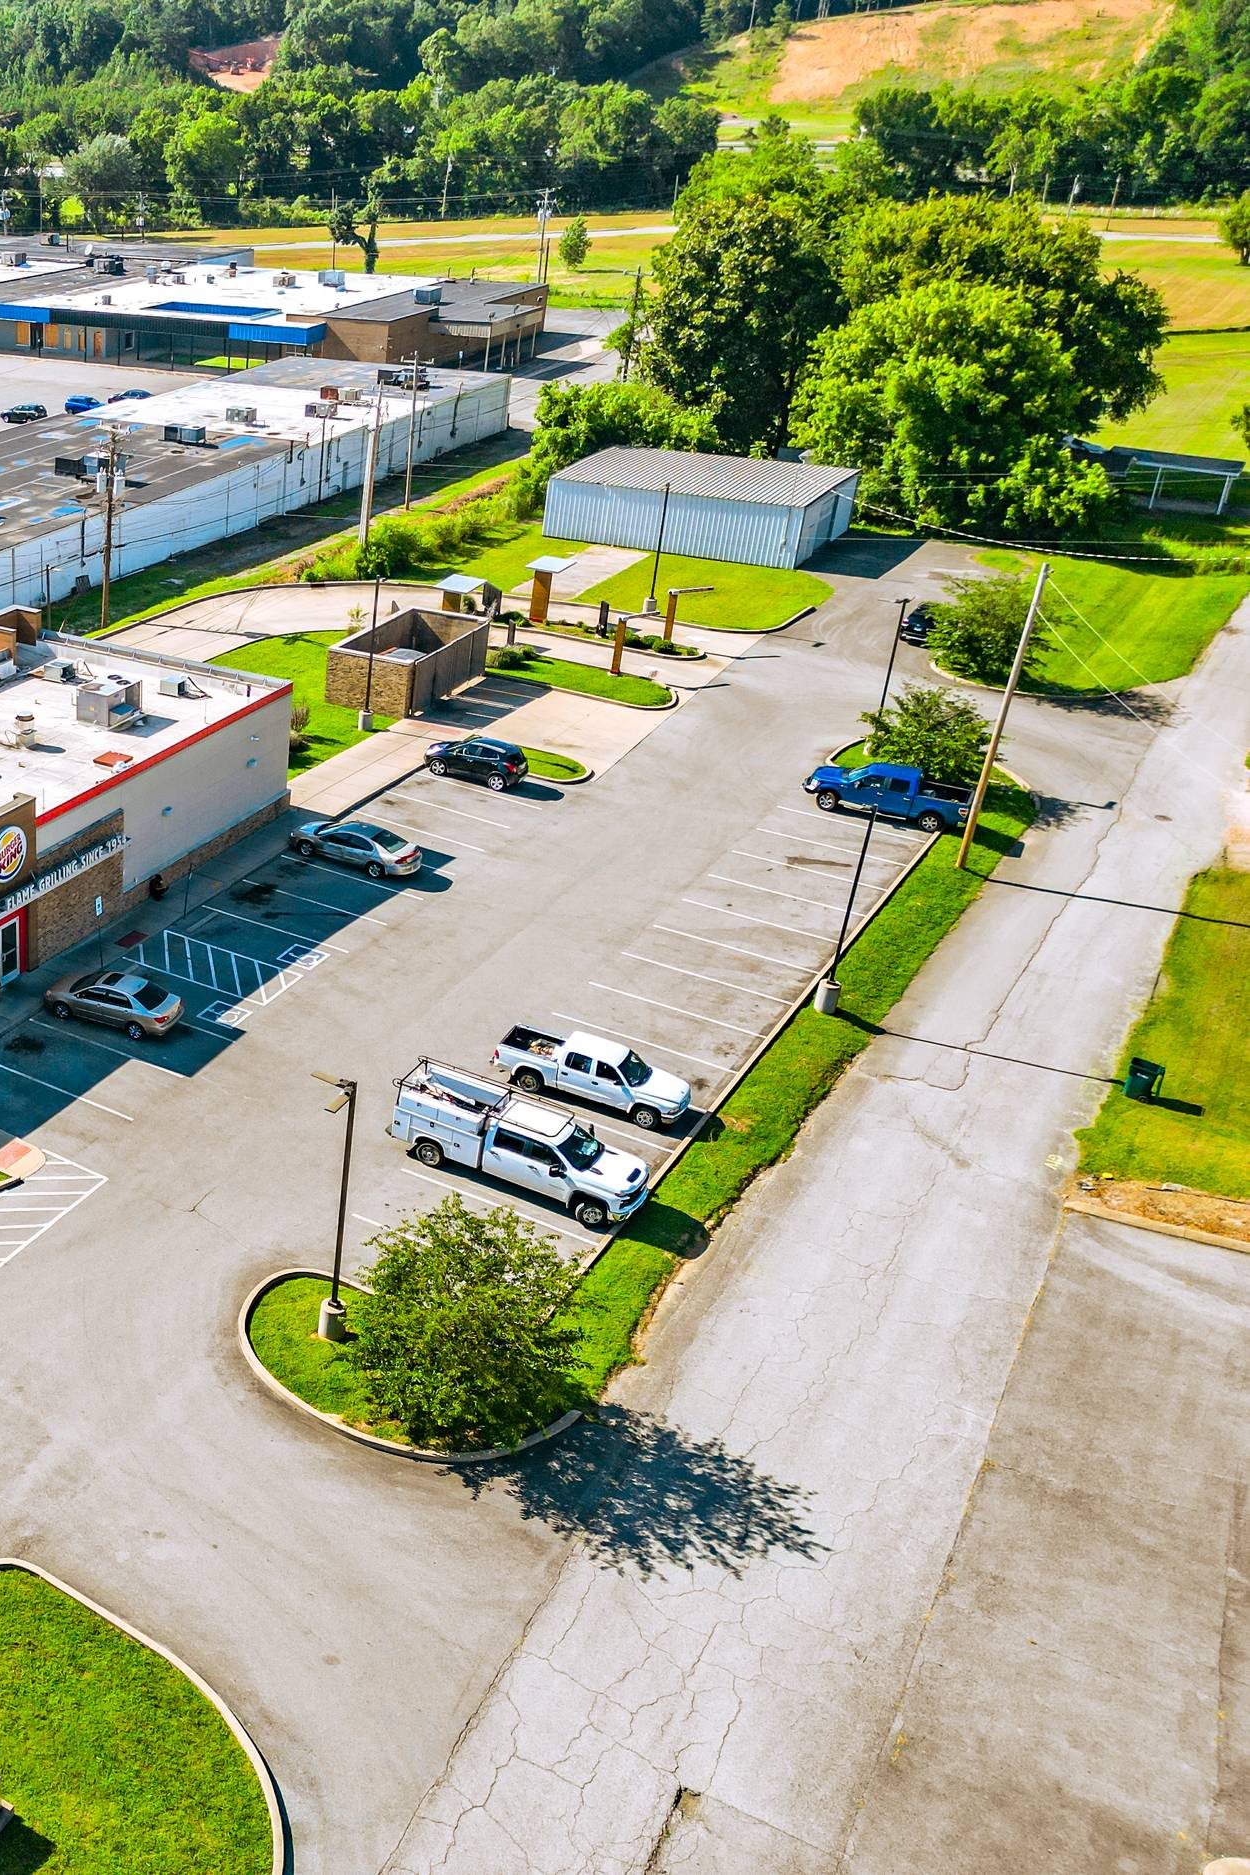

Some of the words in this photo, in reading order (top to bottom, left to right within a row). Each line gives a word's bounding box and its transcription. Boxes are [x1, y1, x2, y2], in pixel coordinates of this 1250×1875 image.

[6, 884, 35, 911] FLAME
[38, 860, 79, 890] GRILLING
[80, 846, 104, 869] SINCE
